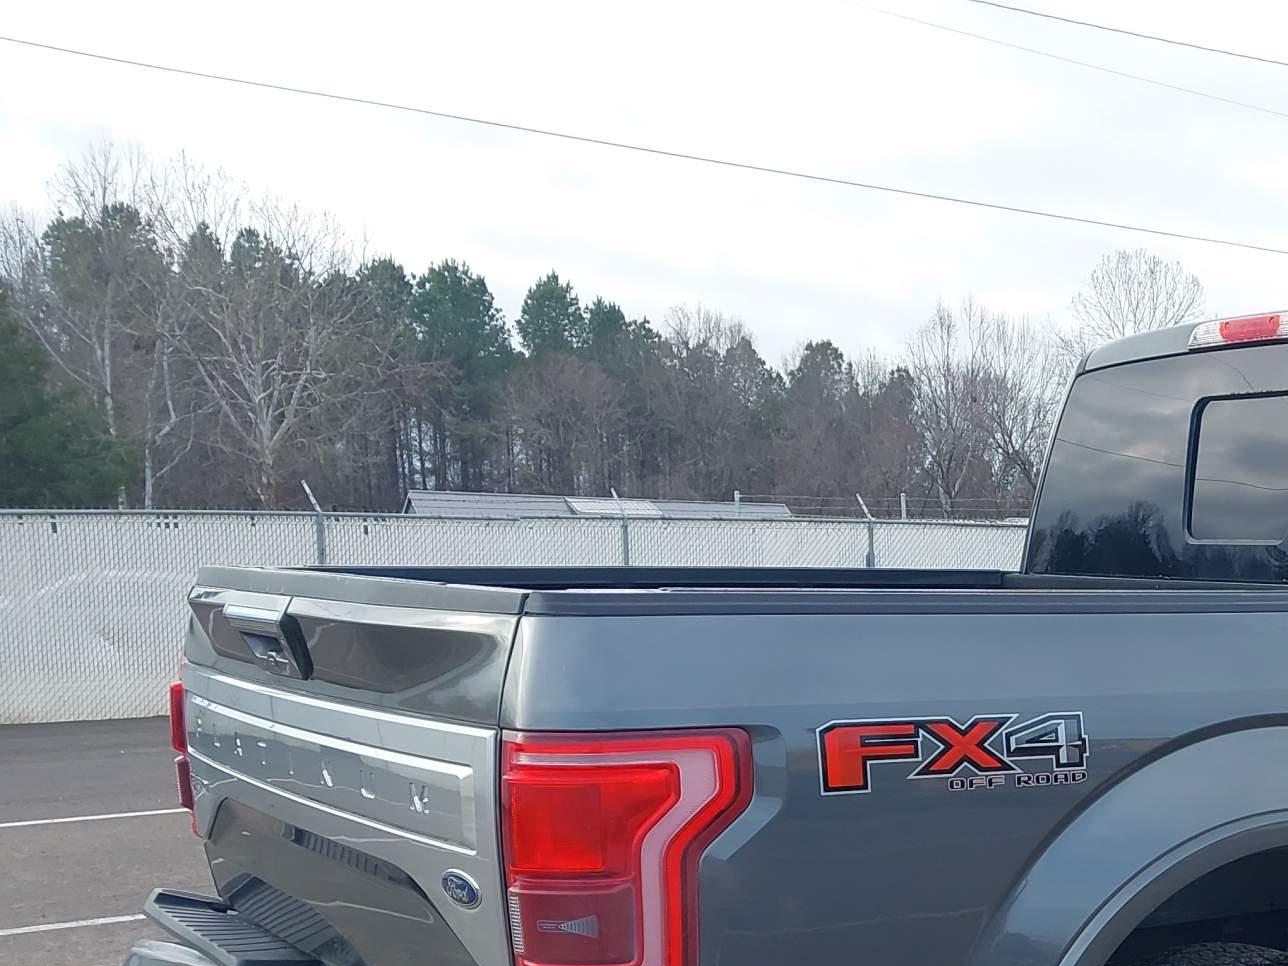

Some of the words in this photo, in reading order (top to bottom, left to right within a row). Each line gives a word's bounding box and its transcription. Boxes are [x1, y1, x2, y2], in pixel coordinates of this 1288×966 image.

[816, 711, 1090, 795] FX4
[947, 773, 1006, 791] OFF
[1015, 770, 1088, 788] ROAD
